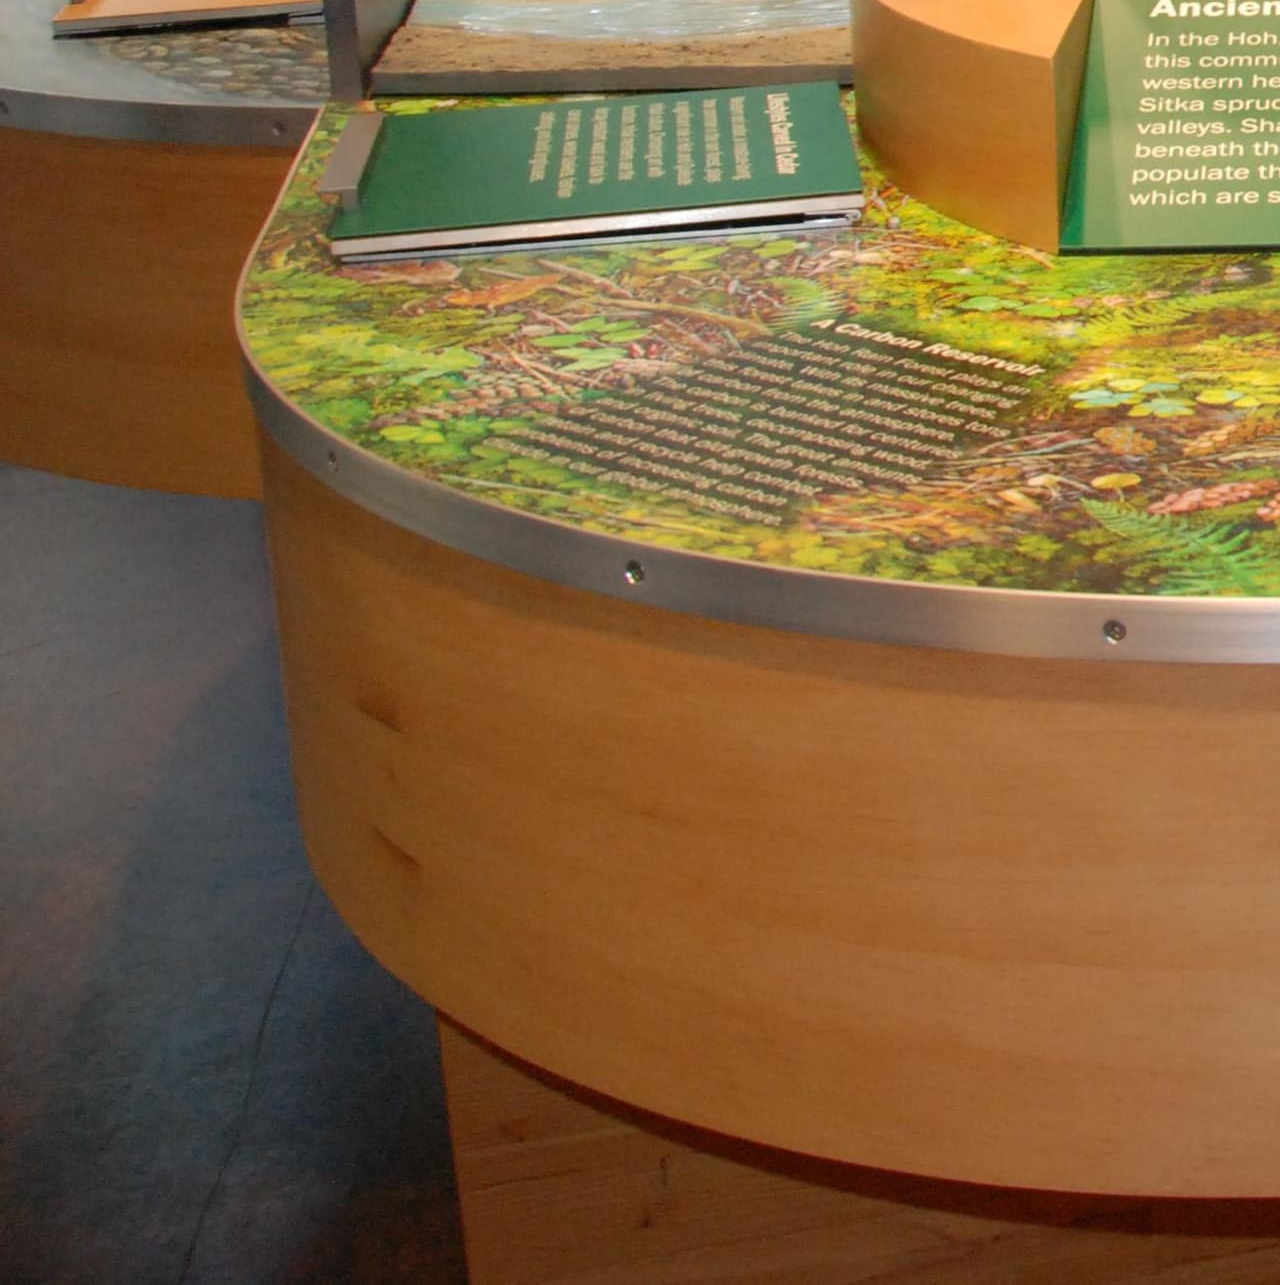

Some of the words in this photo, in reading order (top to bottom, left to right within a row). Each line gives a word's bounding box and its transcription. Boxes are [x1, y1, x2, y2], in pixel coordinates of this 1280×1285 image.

[1148, 33, 1169, 46] In
[1178, 32, 1218, 46] the
[1144, 54, 1191, 67] this
[1142, 76, 1242, 89] western
[1139, 97, 1203, 112] Sitka
[1137, 119, 1231, 136] valleys.
[1135, 141, 1243, 157] beneath
[1132, 165, 1249, 183] populate
[1129, 189, 1206, 205] which
[1215, 191, 1259, 203] are
[809, 318, 835, 329] A
[834, 323, 922, 349] Carbon
[921, 343, 1046, 379] Reservoir
